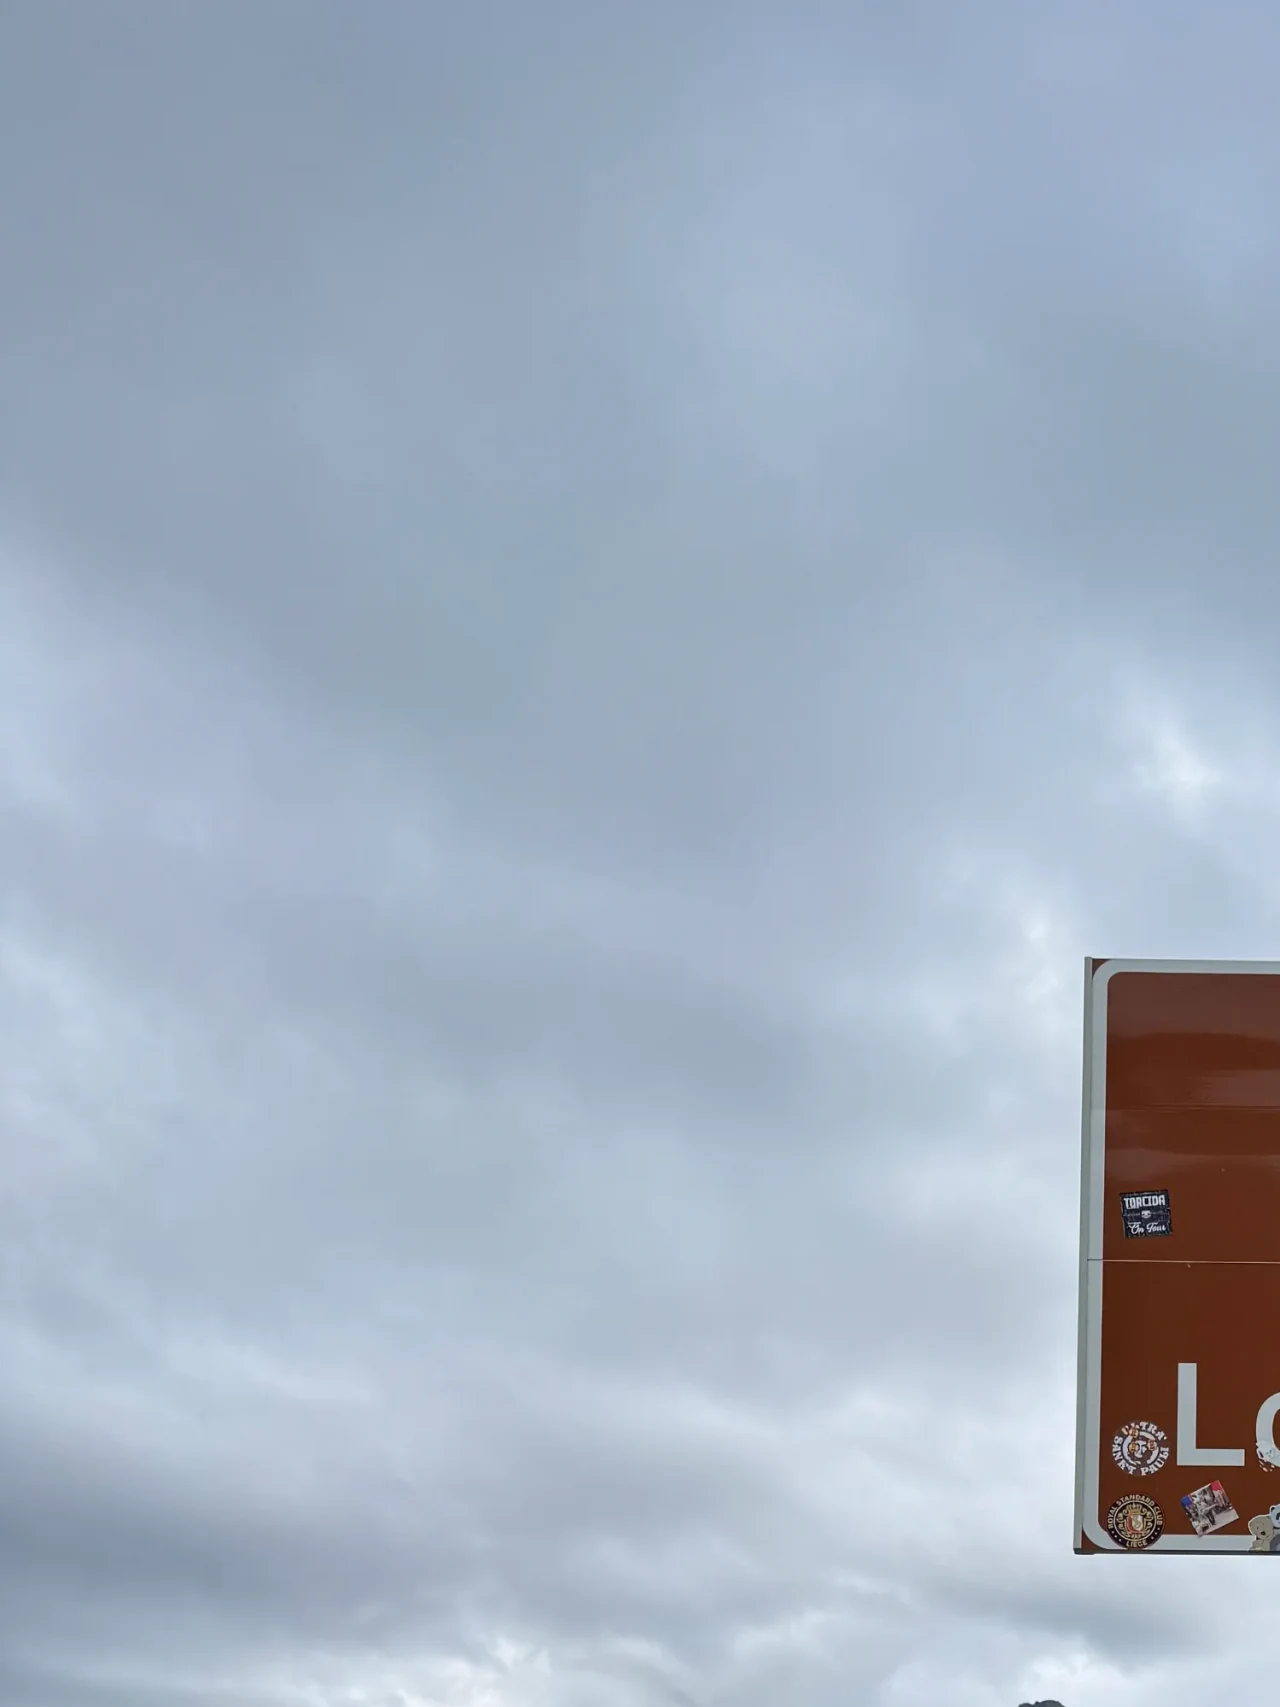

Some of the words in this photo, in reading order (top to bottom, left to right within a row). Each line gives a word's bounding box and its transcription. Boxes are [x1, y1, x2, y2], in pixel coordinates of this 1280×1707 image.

[1123, 1195, 1166, 1209] TORCIDA
[1146, 1222, 1167, 1234] Tour
[1112, 1435, 1137, 1475] SANKT
[1140, 1446, 1169, 1476] PAULI
[1116, 1494, 1155, 1508] STANDARD
[1153, 1505, 1163, 1526] CLUB
